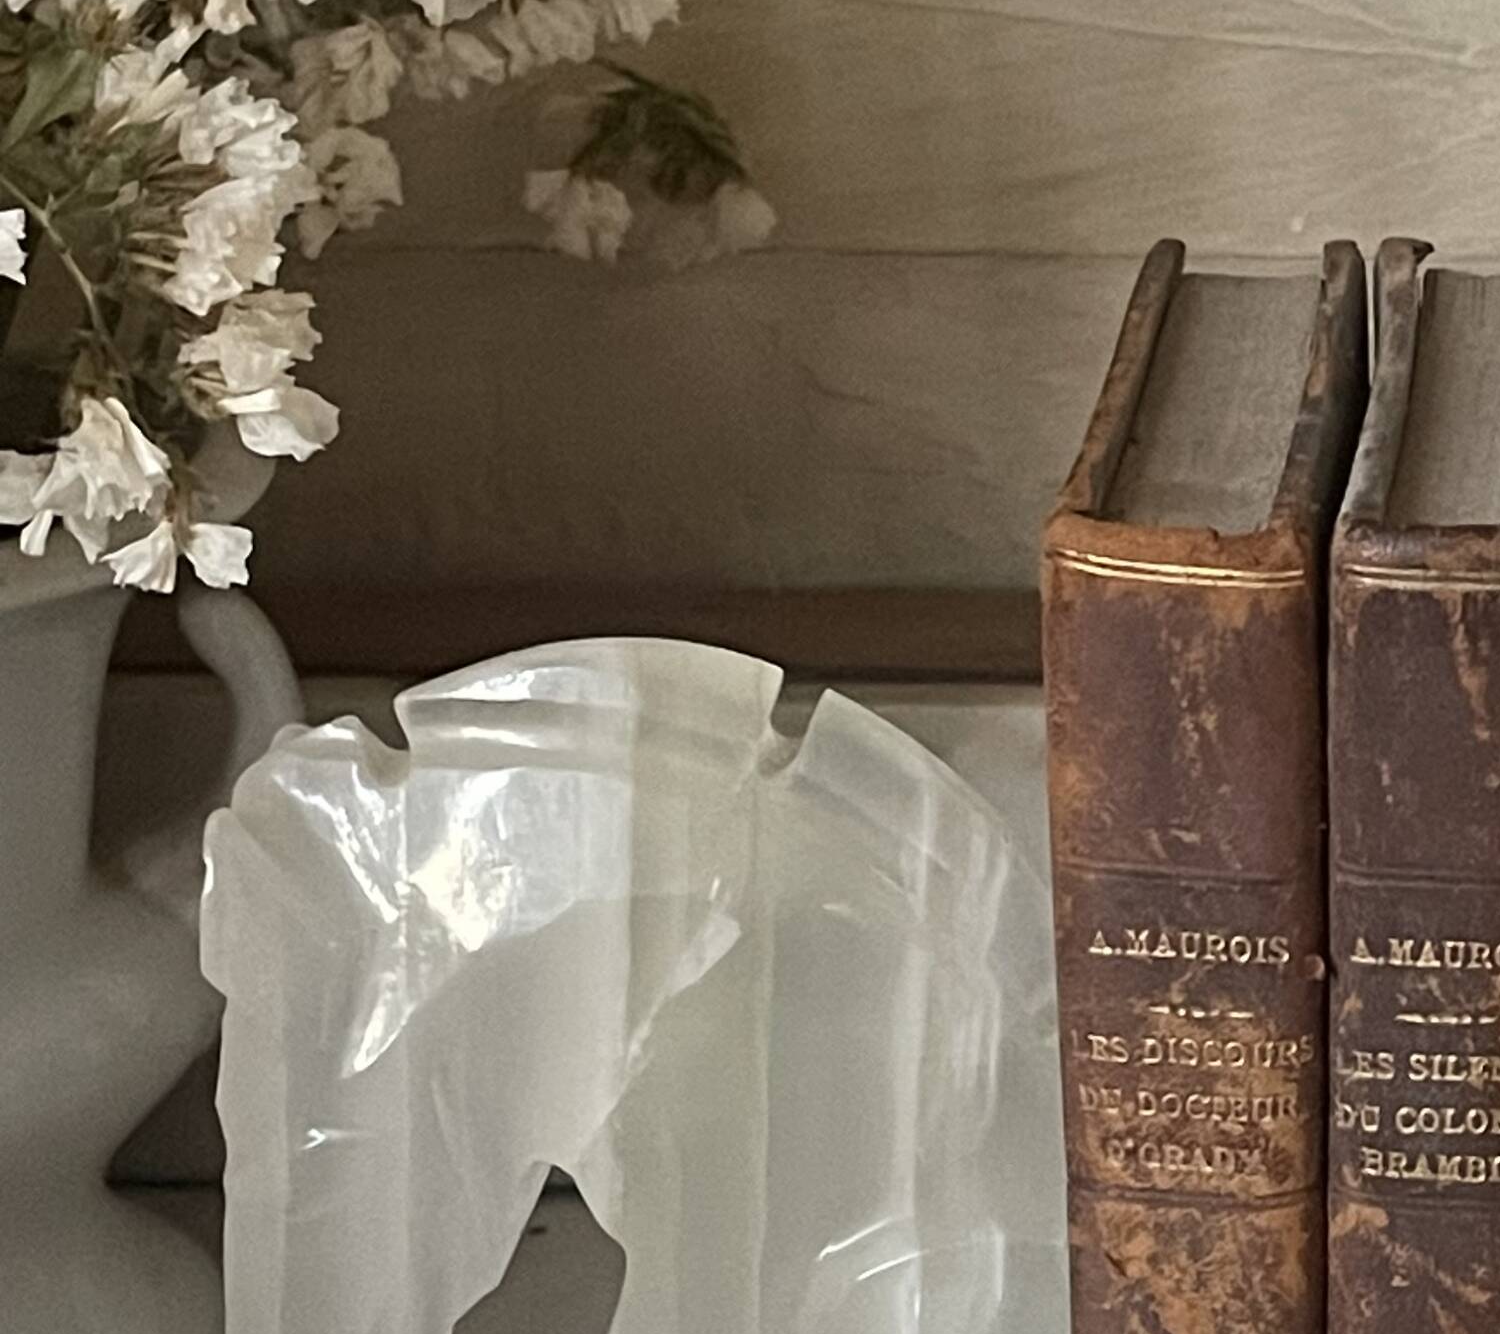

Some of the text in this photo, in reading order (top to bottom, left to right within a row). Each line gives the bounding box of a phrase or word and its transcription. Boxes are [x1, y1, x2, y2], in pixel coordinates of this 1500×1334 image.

[1087, 928, 1291, 964] A.MAUROIS
[1141, 1033, 1315, 1067] DISCOURS
[1335, 1046, 1395, 1081] LES
[1136, 1088, 1299, 1123] DOCTEUR
[1335, 1102, 1381, 1132] DU
